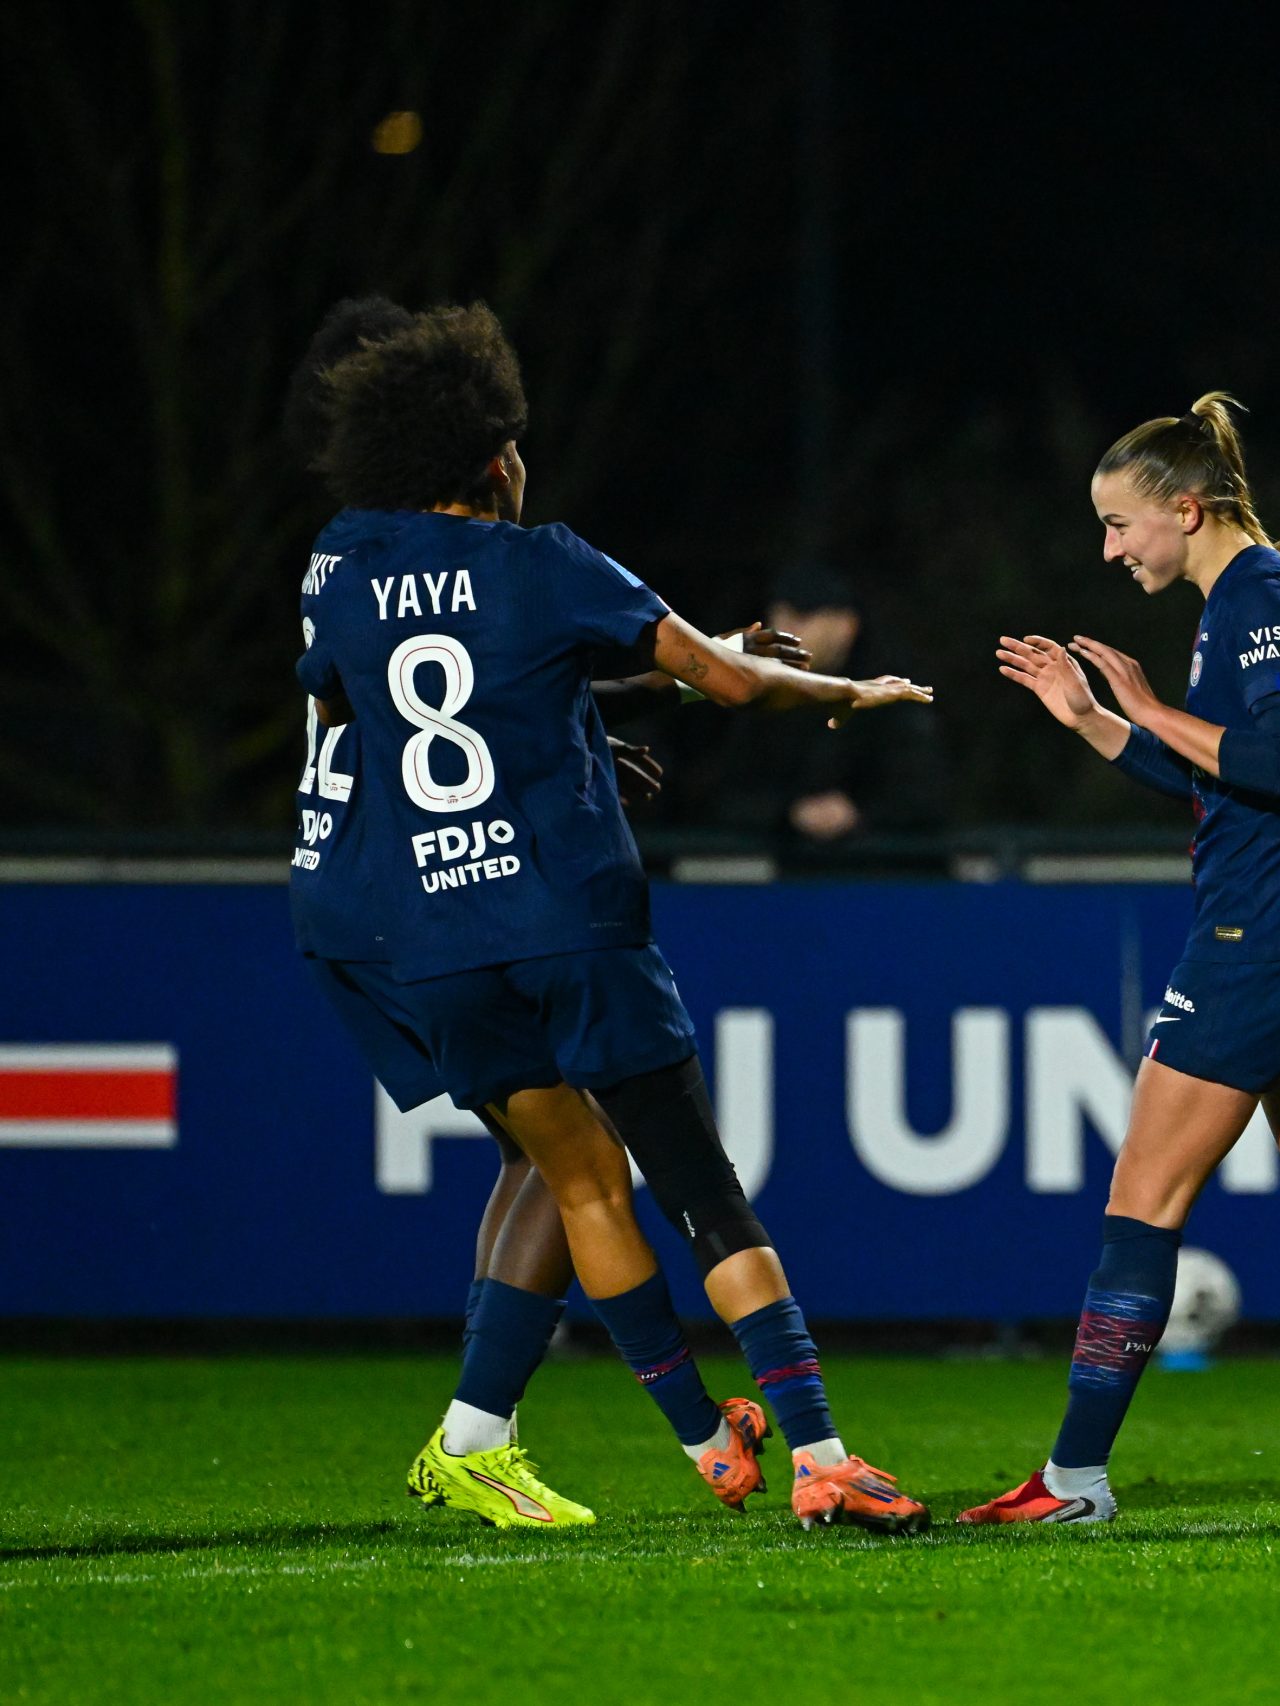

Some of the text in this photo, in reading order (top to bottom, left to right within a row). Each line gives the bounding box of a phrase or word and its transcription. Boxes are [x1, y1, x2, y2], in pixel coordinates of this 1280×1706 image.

[371, 569, 477, 621] YAYA
[387, 633, 495, 813] 8
[421, 855, 520, 894] UNITED
[1125, 1341, 1152, 1352] PA
